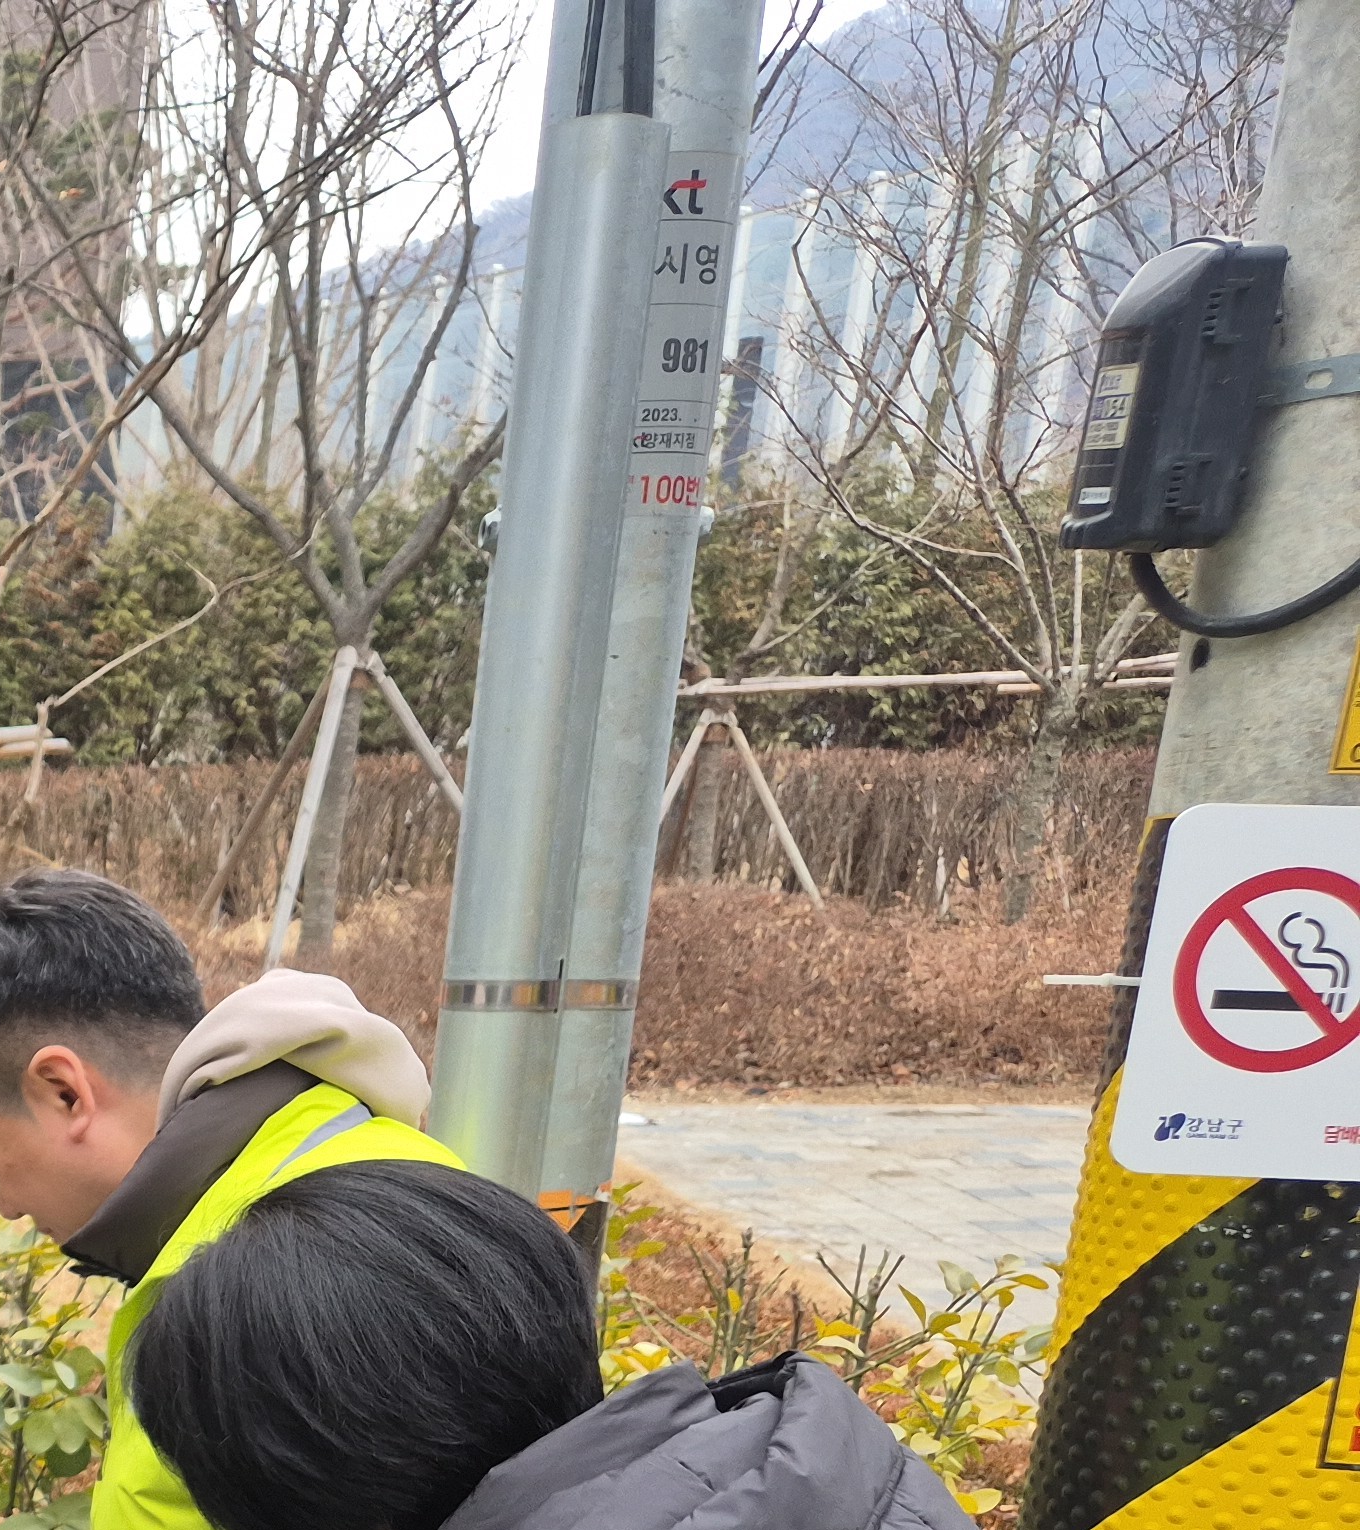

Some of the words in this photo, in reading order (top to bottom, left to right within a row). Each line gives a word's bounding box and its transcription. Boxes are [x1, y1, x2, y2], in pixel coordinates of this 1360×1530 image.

[663, 169, 707, 214] kt
[654, 243, 719, 285] 시영
[662, 338, 709, 374] 981
[641, 475, 701, 507] 100번
[1187, 1118, 1244, 1133] 강남구
